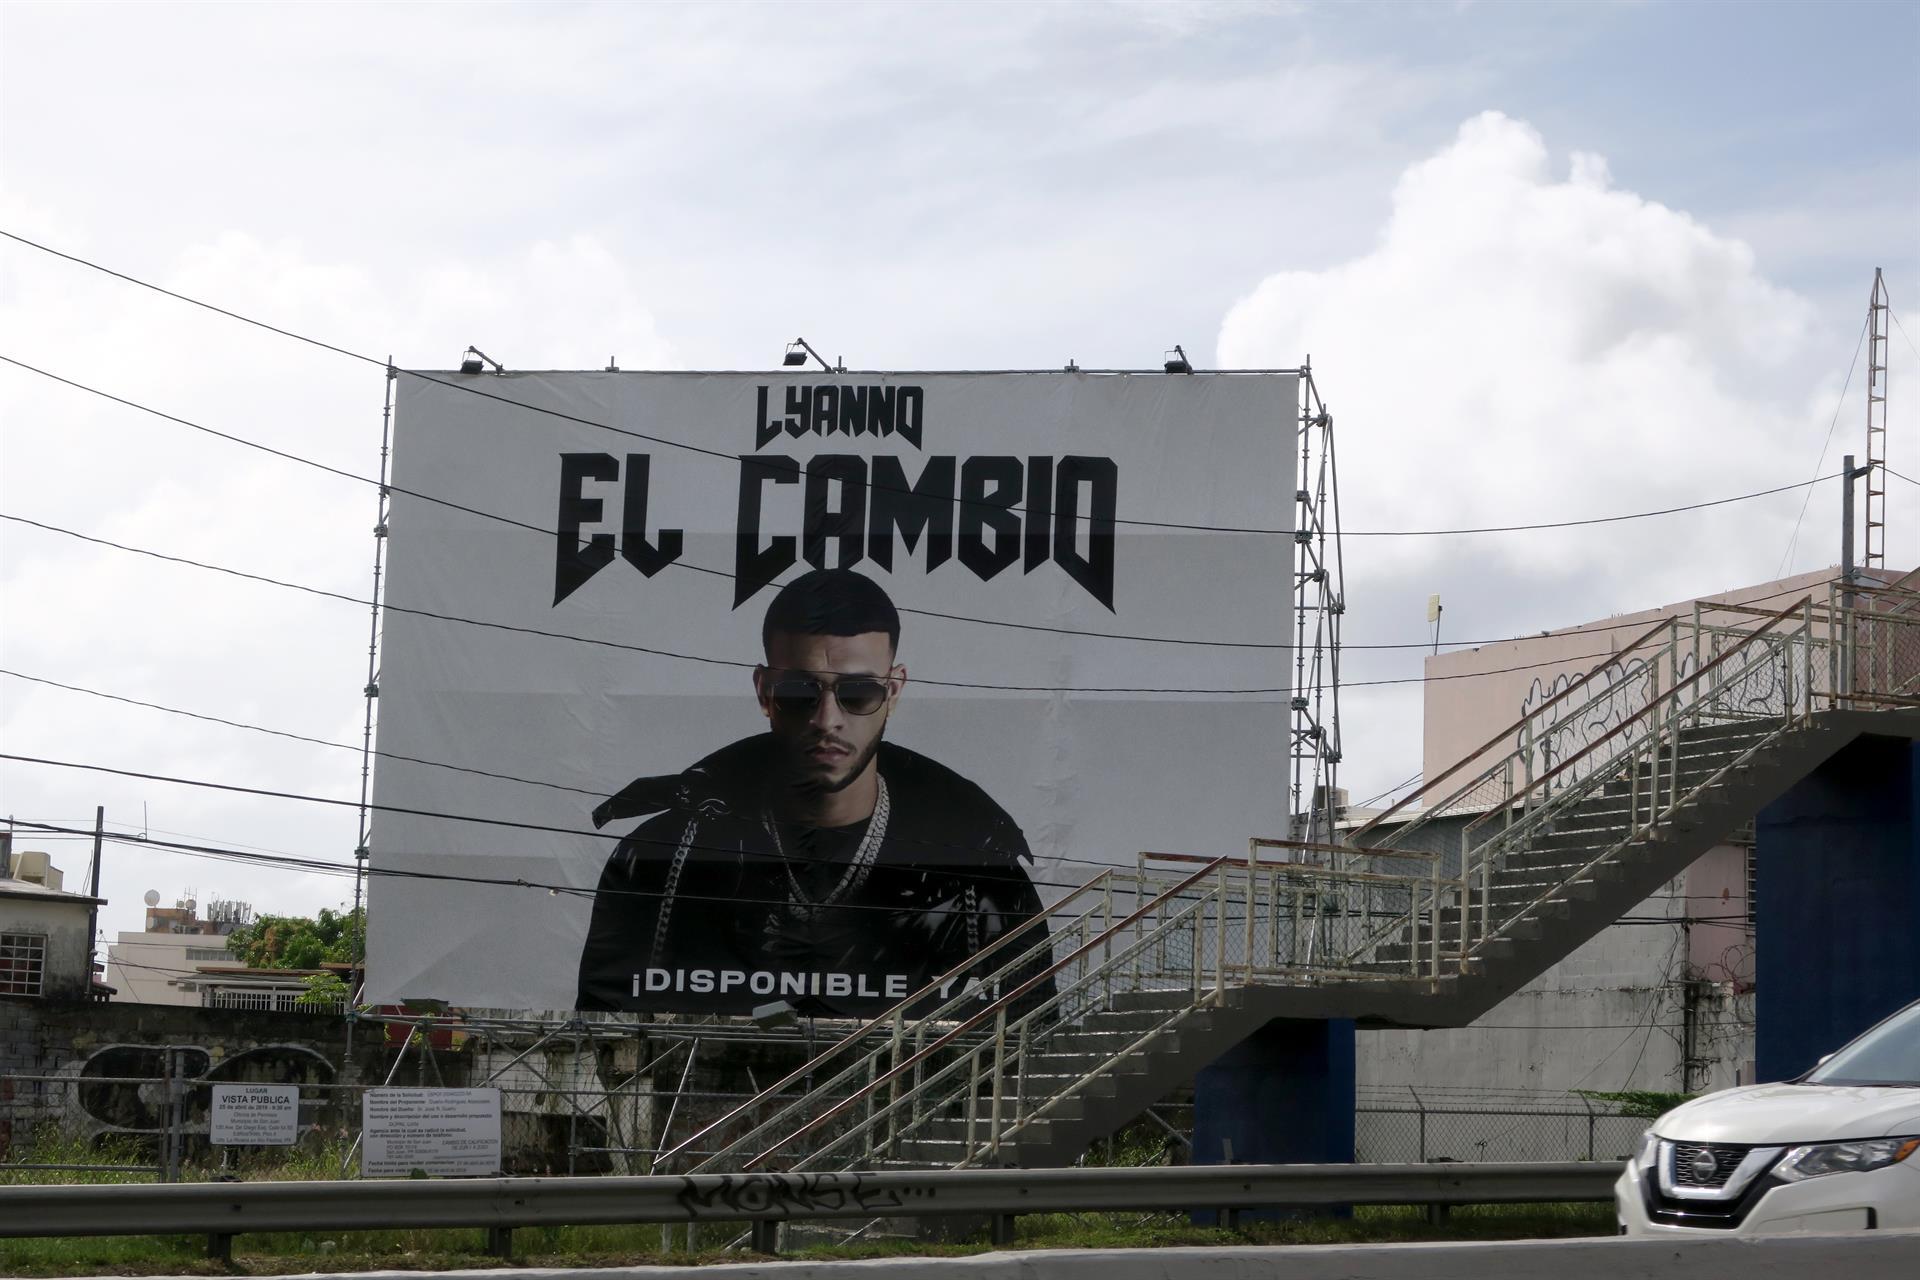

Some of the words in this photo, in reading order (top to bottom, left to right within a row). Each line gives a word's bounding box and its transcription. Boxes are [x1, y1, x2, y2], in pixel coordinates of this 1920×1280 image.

[756, 386, 924, 451] LYANNO
[552, 452, 683, 609] EL
[731, 454, 1118, 615] CAMBIO
[221, 1095, 248, 1104] VISTA
[250, 1095, 290, 1104] PUBLICA
